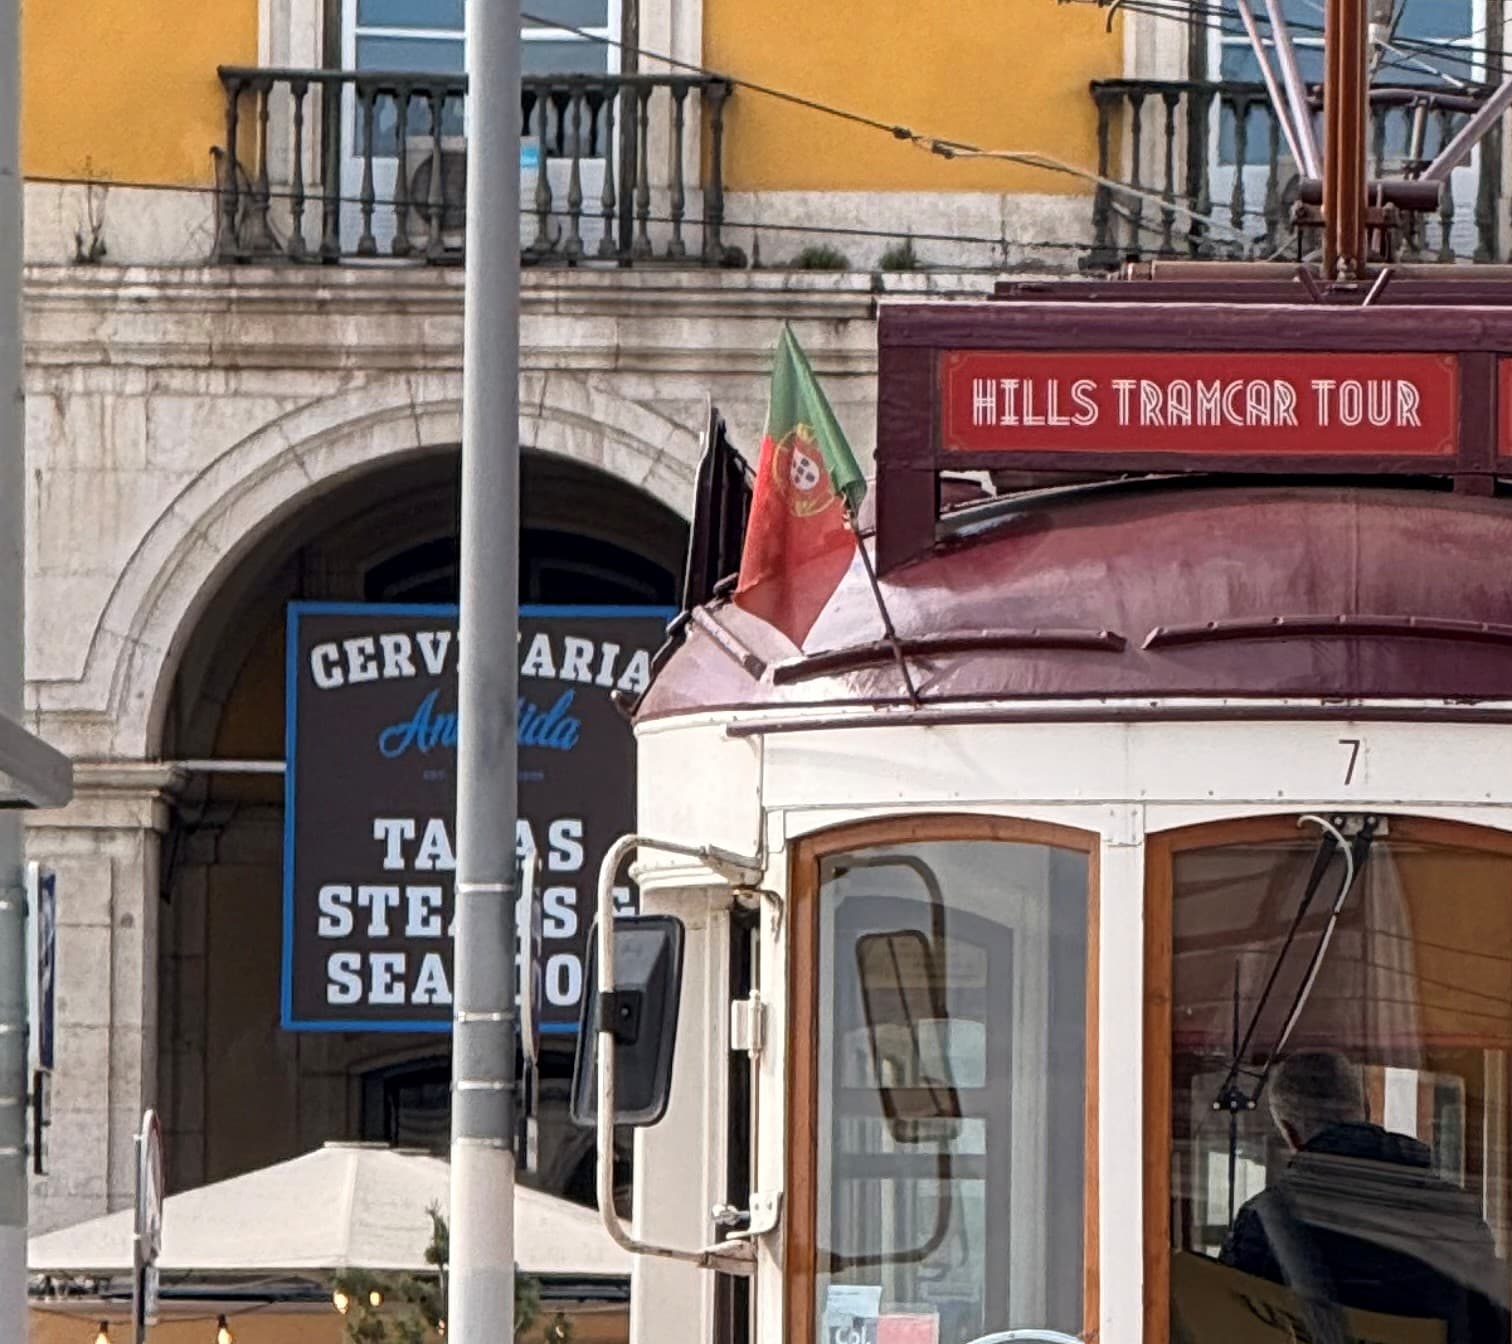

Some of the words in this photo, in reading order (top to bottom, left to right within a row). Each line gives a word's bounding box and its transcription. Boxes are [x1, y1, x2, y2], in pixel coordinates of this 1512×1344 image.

[972, 378, 1099, 427] HILLS
[1111, 379, 1299, 427] TRAMCAR
[1311, 379, 1422, 428] TOUR
[311, 631, 651, 693] CERVARIA
[1338, 739, 1361, 786] 7
[373, 818, 584, 871] TAAS
[318, 885, 578, 939] STES
